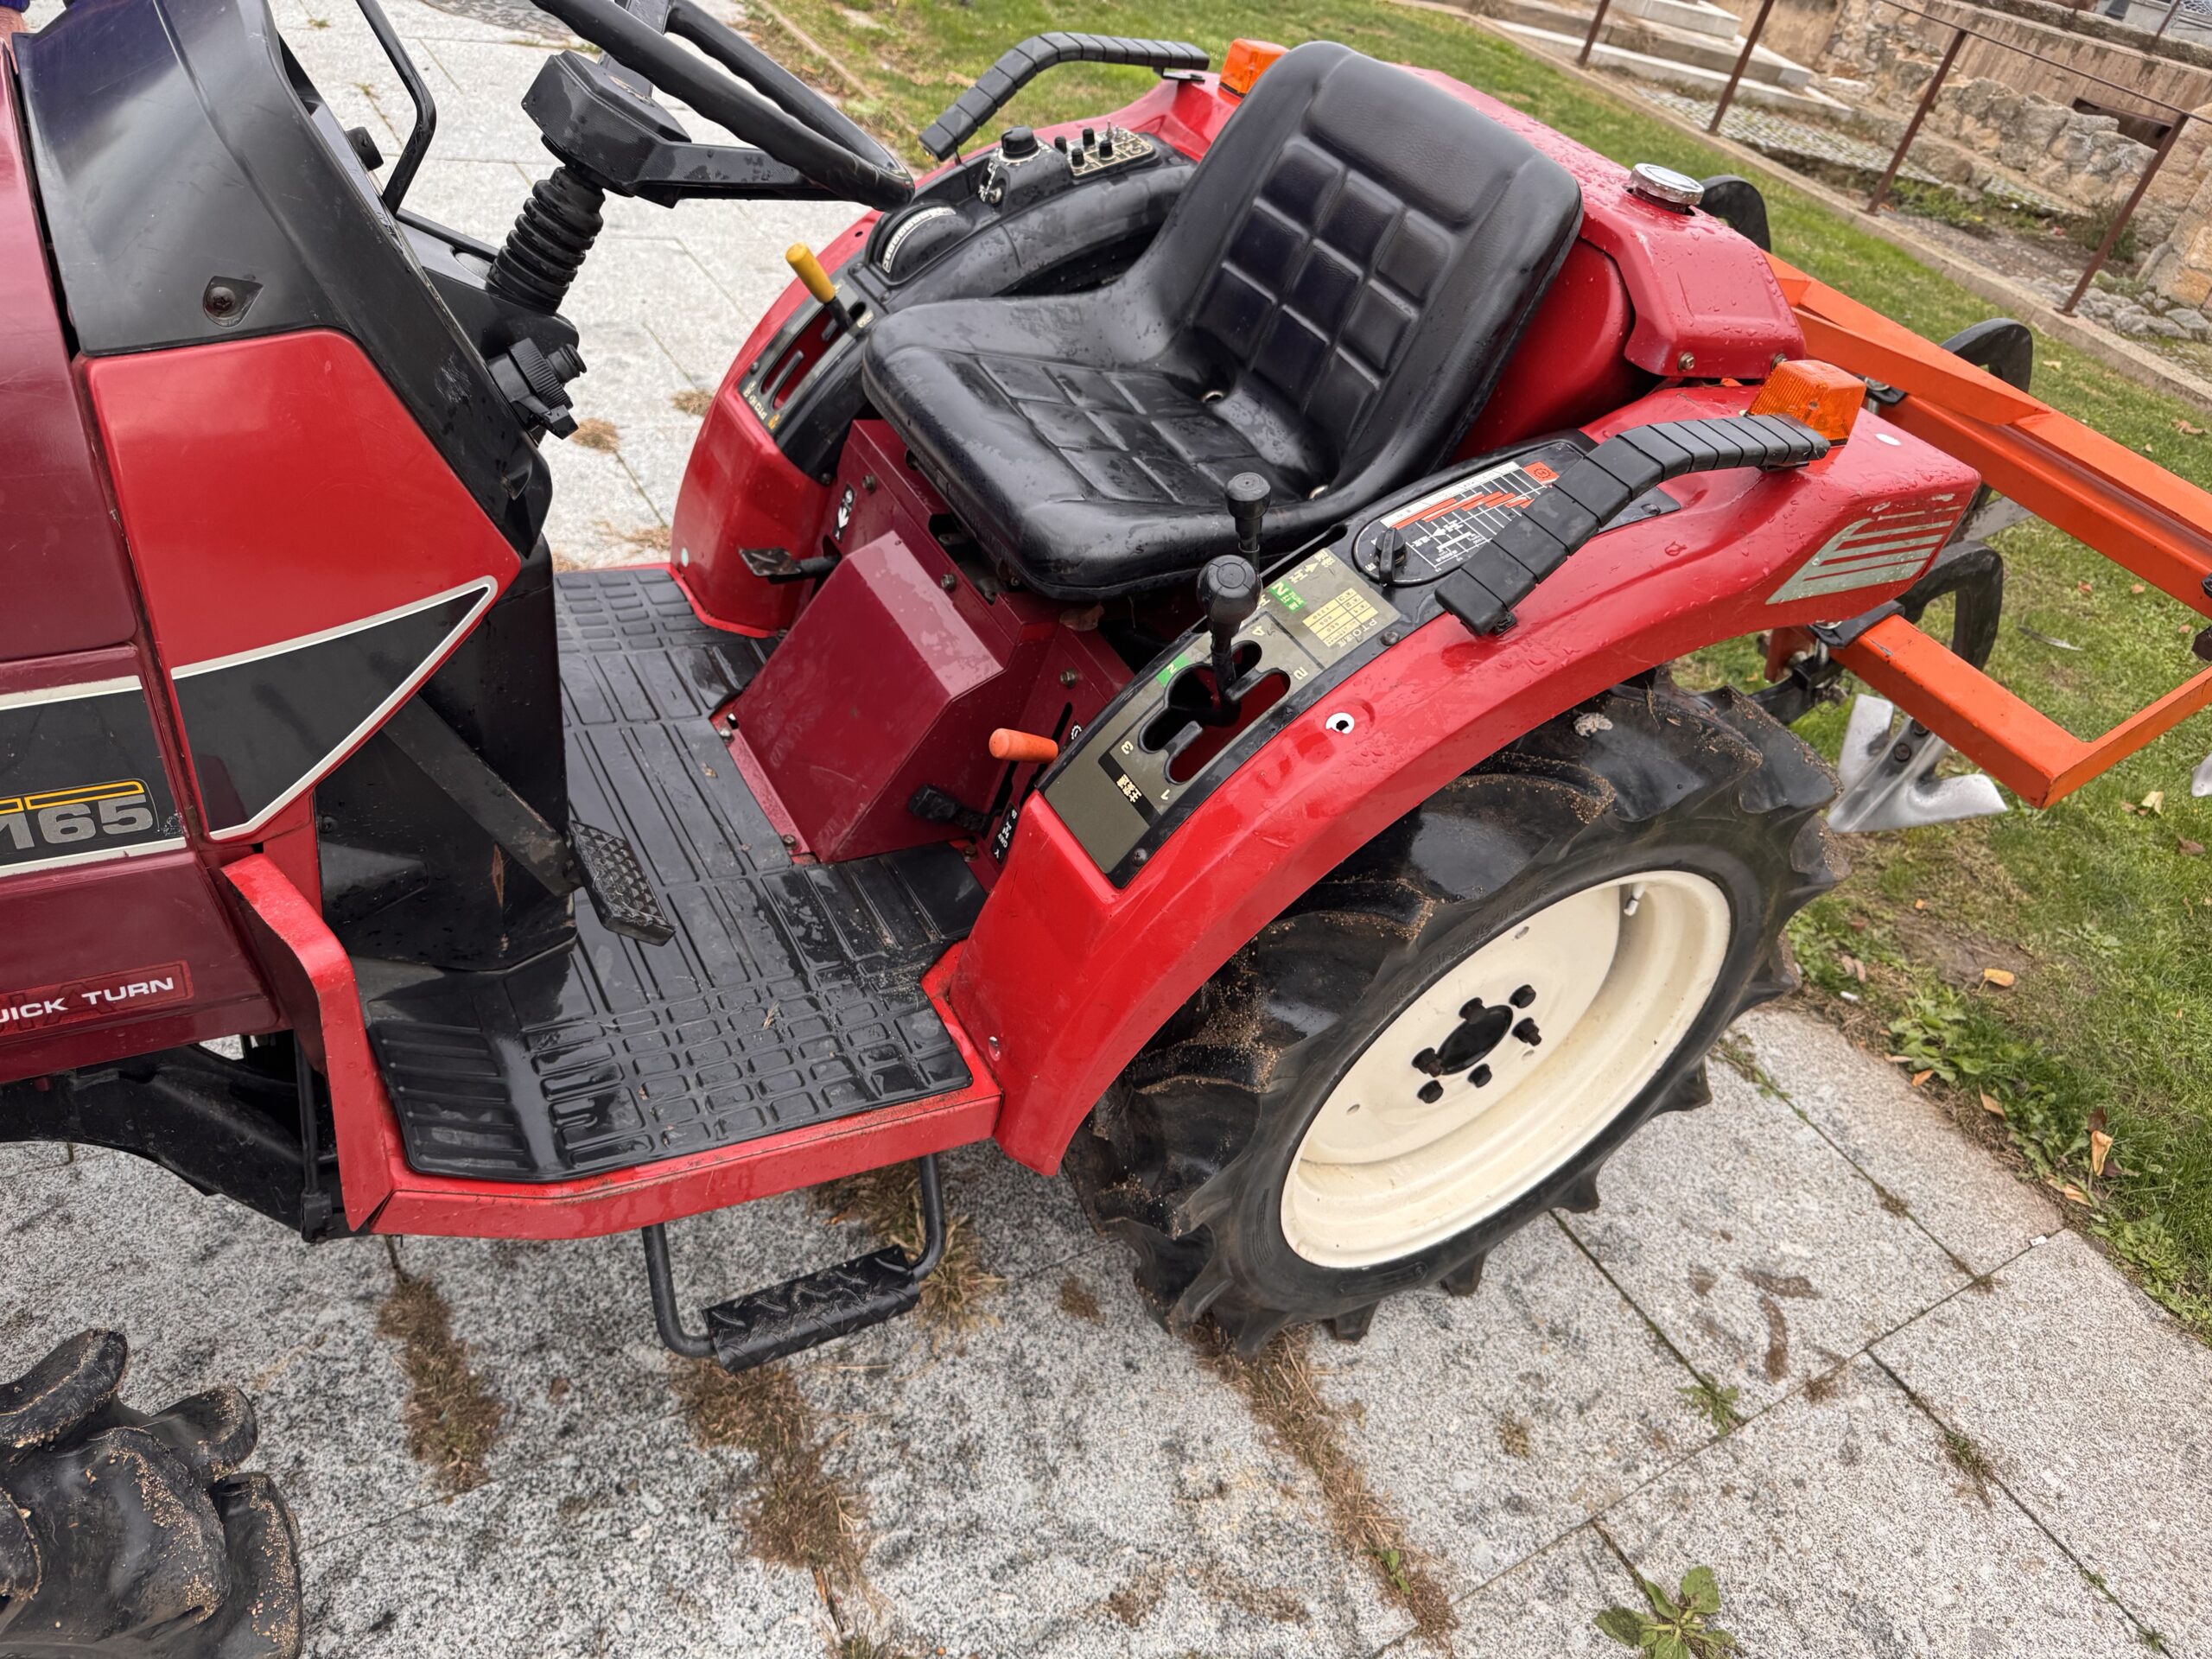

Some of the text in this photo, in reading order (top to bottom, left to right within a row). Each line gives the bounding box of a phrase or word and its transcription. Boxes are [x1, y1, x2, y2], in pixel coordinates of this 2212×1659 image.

[1271, 582, 1287, 596] N
[1251, 625, 1266, 637] 4
[1166, 663, 1177, 675] N
[1293, 666, 1309, 680] 2
[1121, 741, 1134, 755] 3
[1160, 788, 1171, 801] 1
[81, 977, 175, 1006] TURN
